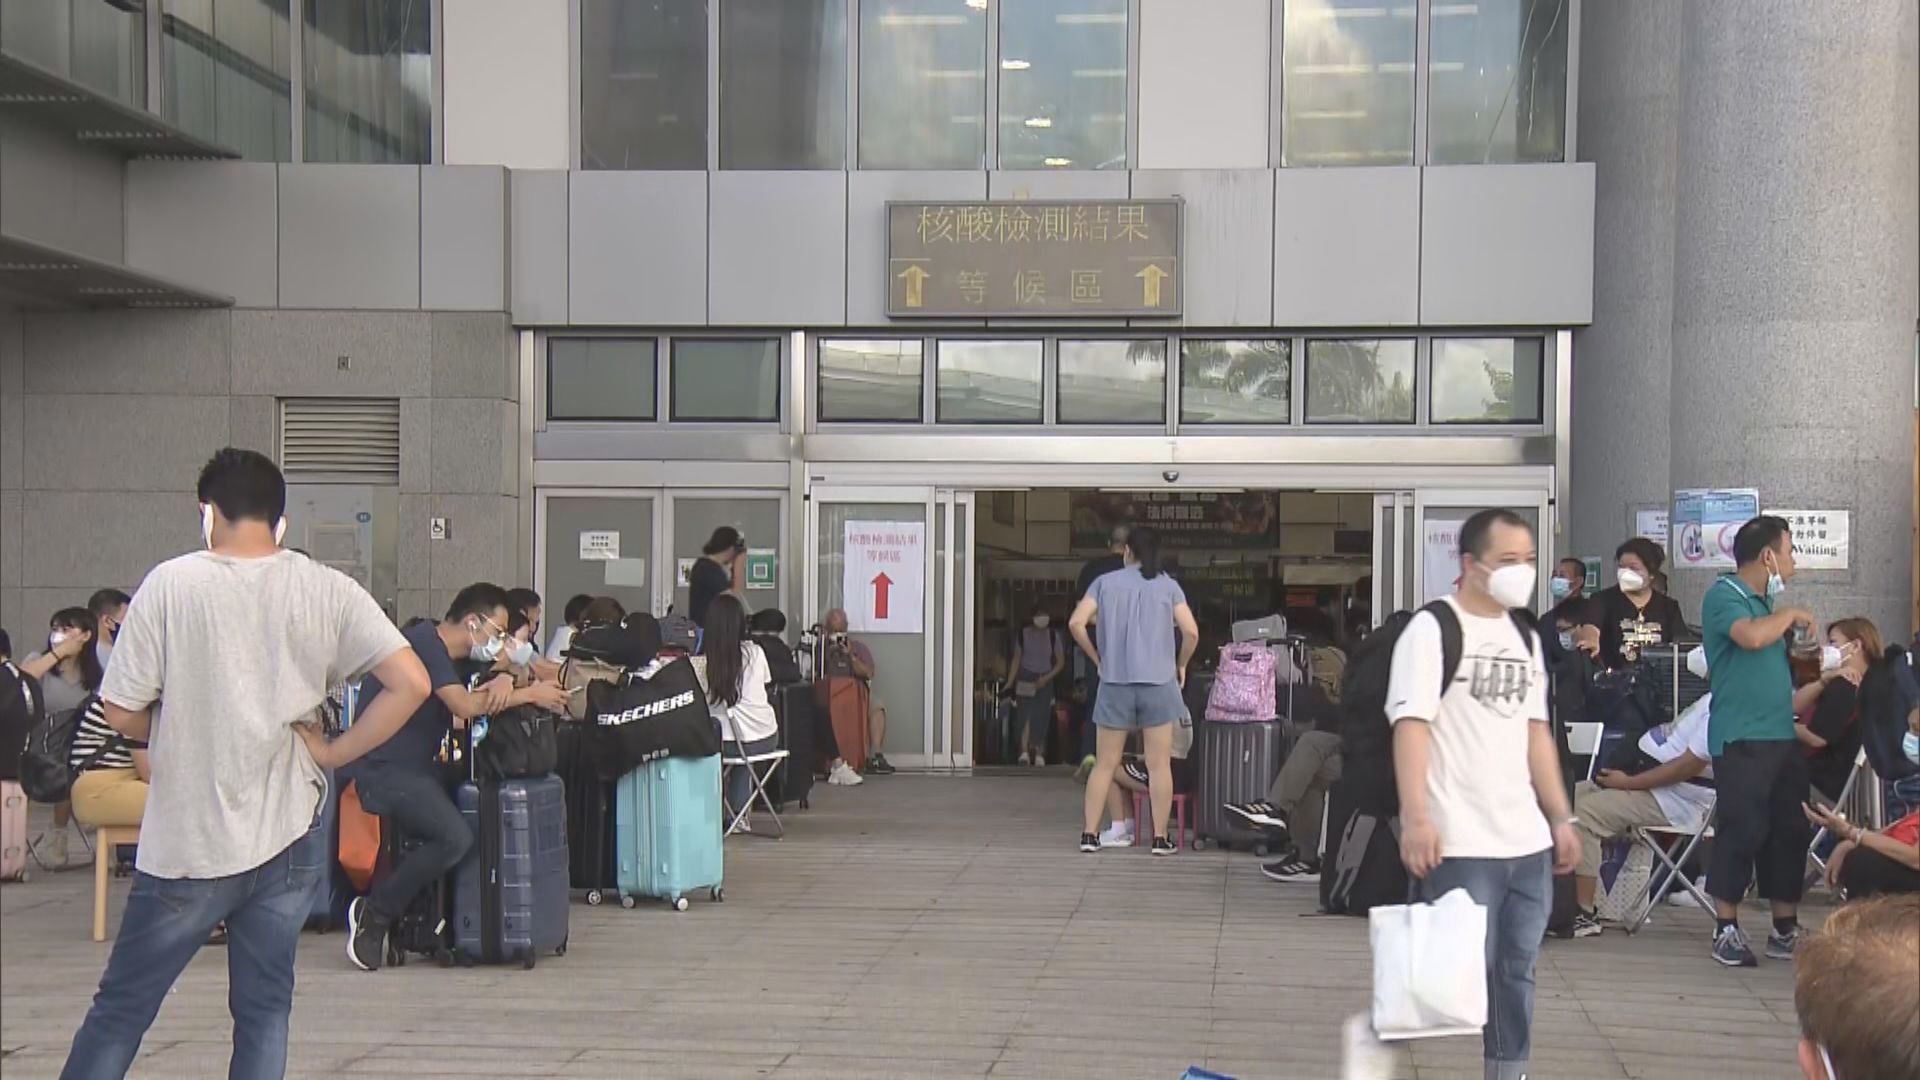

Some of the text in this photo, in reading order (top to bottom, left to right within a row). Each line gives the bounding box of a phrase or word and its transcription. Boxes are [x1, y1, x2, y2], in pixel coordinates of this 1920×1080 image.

[917, 205, 1149, 244] 核酸檢測結果
[956, 268, 1102, 304] 等候區
[597, 689, 695, 726] SKECHERS
